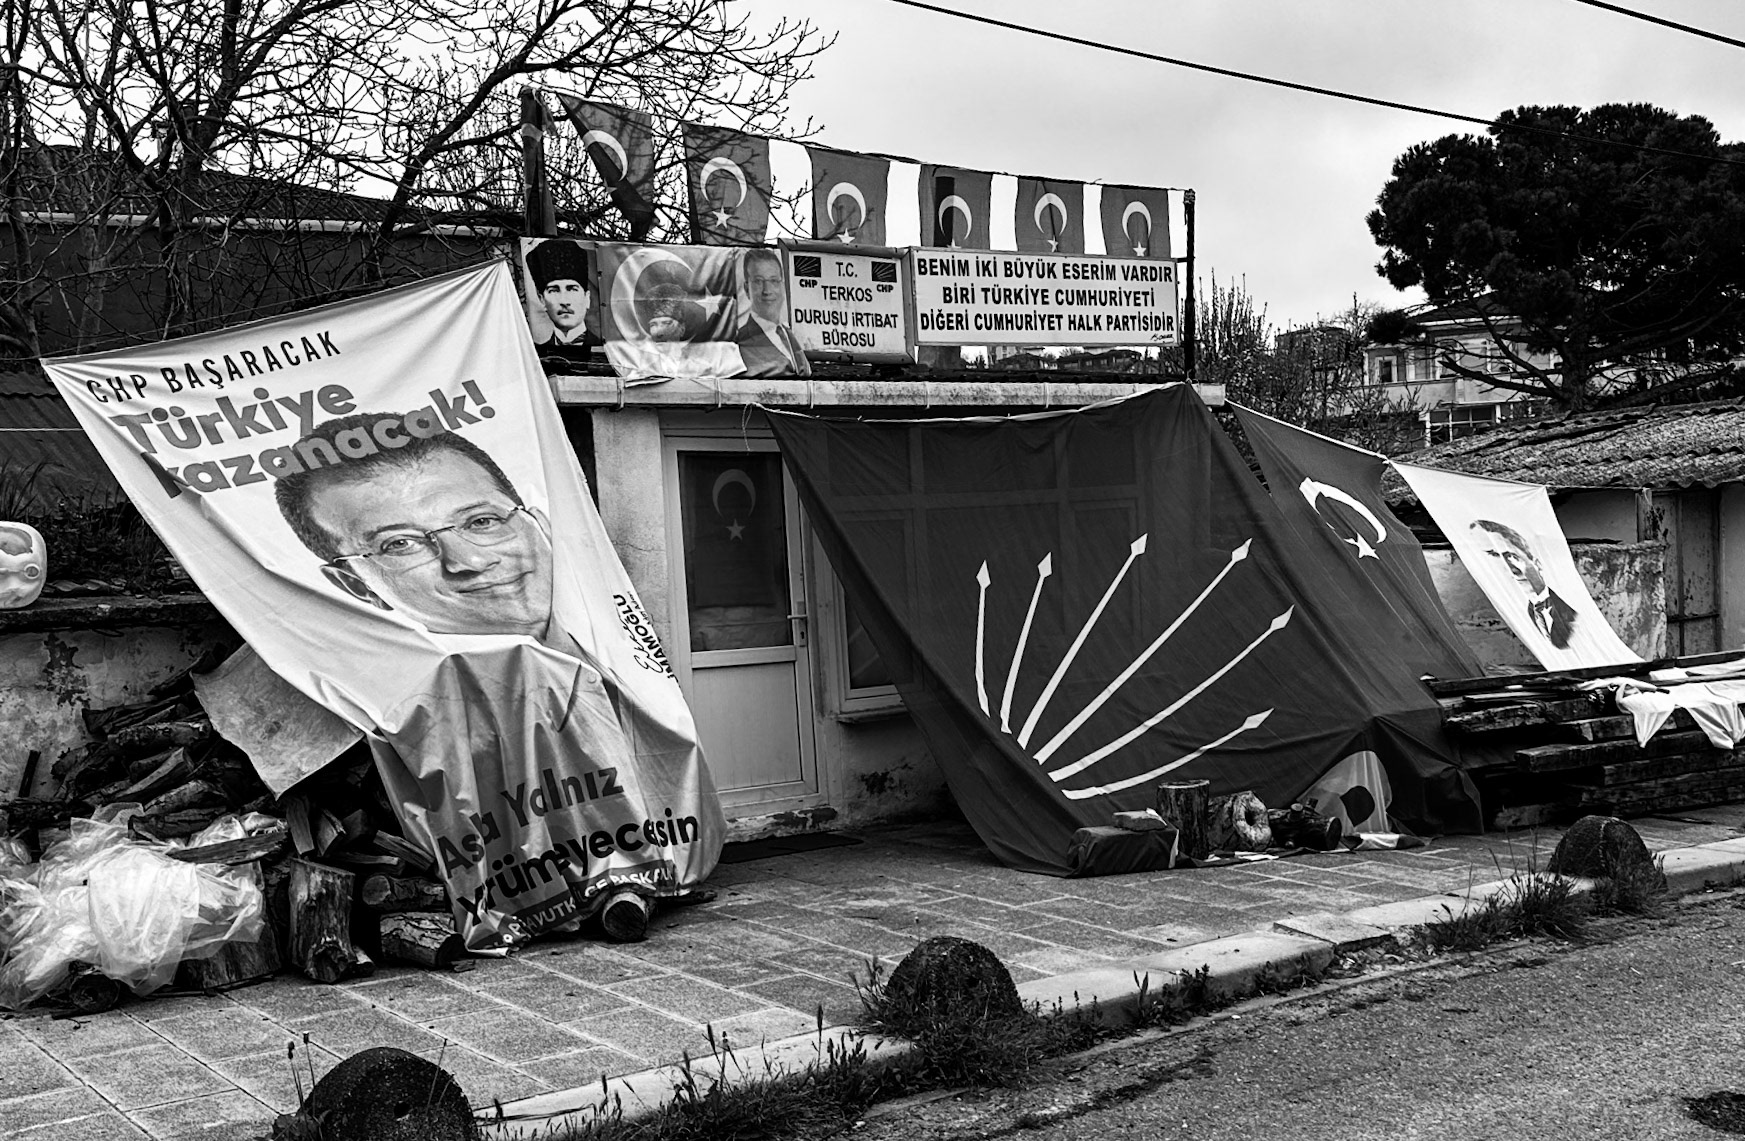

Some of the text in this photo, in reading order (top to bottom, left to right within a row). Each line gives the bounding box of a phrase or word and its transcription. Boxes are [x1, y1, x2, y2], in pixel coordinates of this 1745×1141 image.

[835, 262, 858, 278] T.C.
[917, 255, 1173, 282] BENİM İKİ BÜYÜK ESERİM VARDIR
[799, 279, 818, 288] CHP
[821, 285, 873, 302] TERKOS
[876, 284, 894, 293] CHP
[943, 282, 1155, 307] BİRİ TÜRKİYE CUMHURİYETİ
[794, 309, 848, 326] DURUSU
[920, 309, 1175, 332] DİĞERİ CUMHURİYET HALK PARTİSİDİR
[822, 329, 875, 347] BÜROSU
[86, 331, 342, 403] CHP BAŞARACAK
[108, 384, 358, 454] Türkiye
[140, 379, 496, 499] kazanacak!
[500, 766, 625, 828] Yalnız
